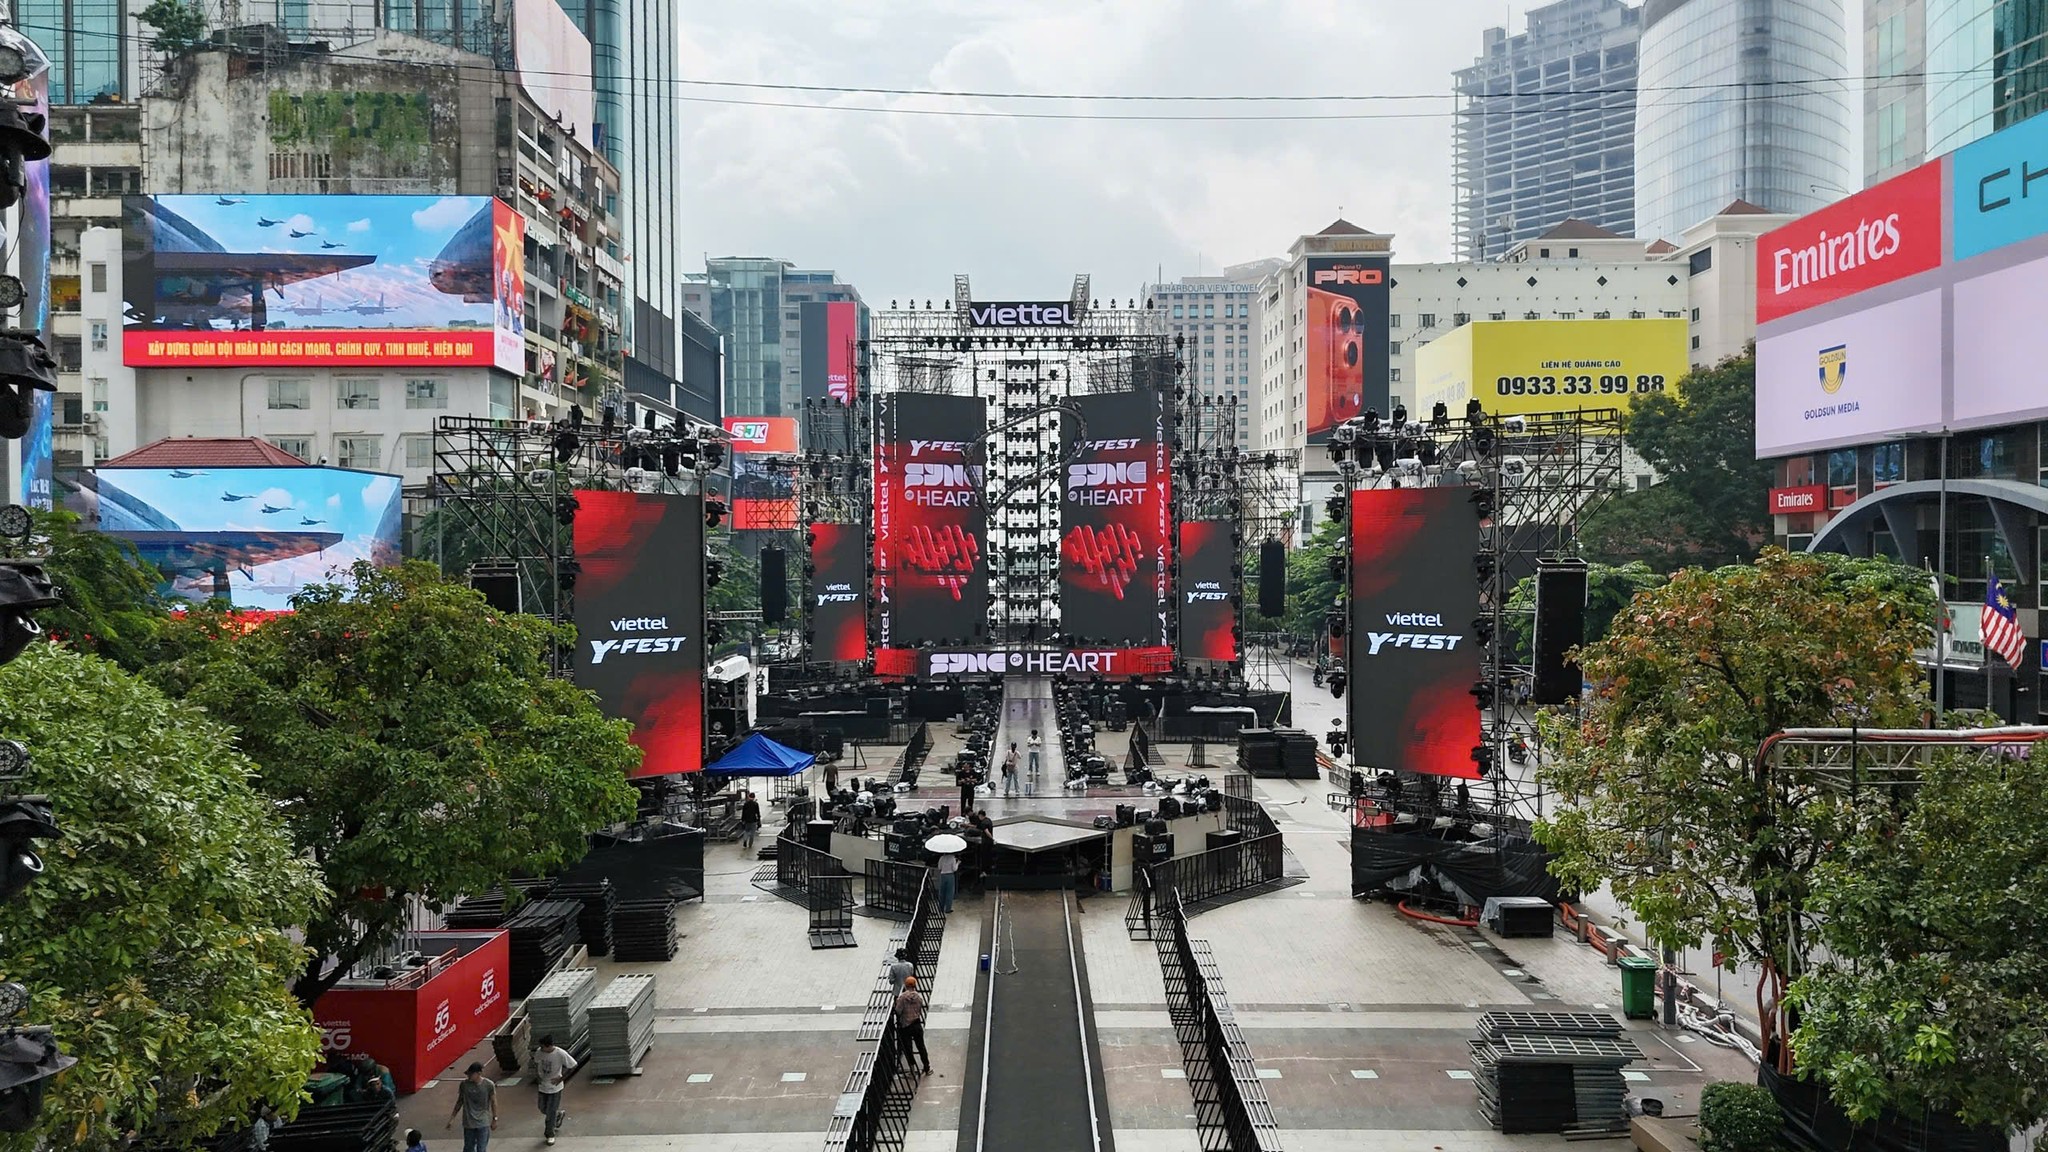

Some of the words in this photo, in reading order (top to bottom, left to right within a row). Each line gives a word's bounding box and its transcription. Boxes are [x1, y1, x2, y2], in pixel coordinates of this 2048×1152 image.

[1774, 213, 1900, 295] Emirates
[1315, 270, 1382, 285] PRO
[1165, 284, 1205, 292] HARBOUR
[1207, 284, 1228, 292] VIEW
[970, 303, 1079, 325] viettel
[148, 341, 165, 356] XÂY
[167, 342, 190, 358] DỰNG
[192, 341, 215, 356] QUÂN
[217, 340, 233, 358] ĐỘI
[235, 340, 258, 356] NHÂN
[260, 341, 278, 356] DÂN
[280, 341, 301, 356] CÁCH
[305, 342, 333, 358] MẠNG,
[336, 341, 362, 356] CHÍNH
[364, 342, 383, 356] QUY,
[386, 342, 404, 356] TINH
[407, 340, 432, 358] NHUỆ,
[434, 340, 453, 358] HIỆN
[1820, 351, 1846, 365] GOLDSUN
[1541, 360, 1560, 368] LIÊN
[1562, 360, 1572, 369] HỆ
[1804, 406, 1836, 420] GOLDSUN
[1837, 401, 1860, 414] MEDIA
[733, 423, 767, 439] SJK
[1156, 414, 1165, 475] viettel
[1068, 461, 1147, 491] SYNC
[1080, 489, 1147, 506] HEART
[1778, 492, 1814, 508] Emirates
[880, 480, 889, 540] viettel
[1157, 482, 1166, 537] Y-FEST
[1157, 544, 1166, 605] viettel
[825, 583, 851, 591] viettel
[1195, 582, 1220, 590] viettel
[817, 593, 858, 606] Y-FEST
[1187, 592, 1228, 603] Y-FEST
[610, 617, 669, 631] viettel
[1386, 612, 1443, 627] viettel
[590, 637, 687, 664] Y-FEST
[1367, 632, 1463, 655] Y-FEST
[930, 653, 1006, 676] SYNC
[1011, 655, 1023, 665] OF
[1027, 652, 1118, 672] HEART
[481, 975, 494, 999] 5G
[435, 1005, 449, 1034] 5G
